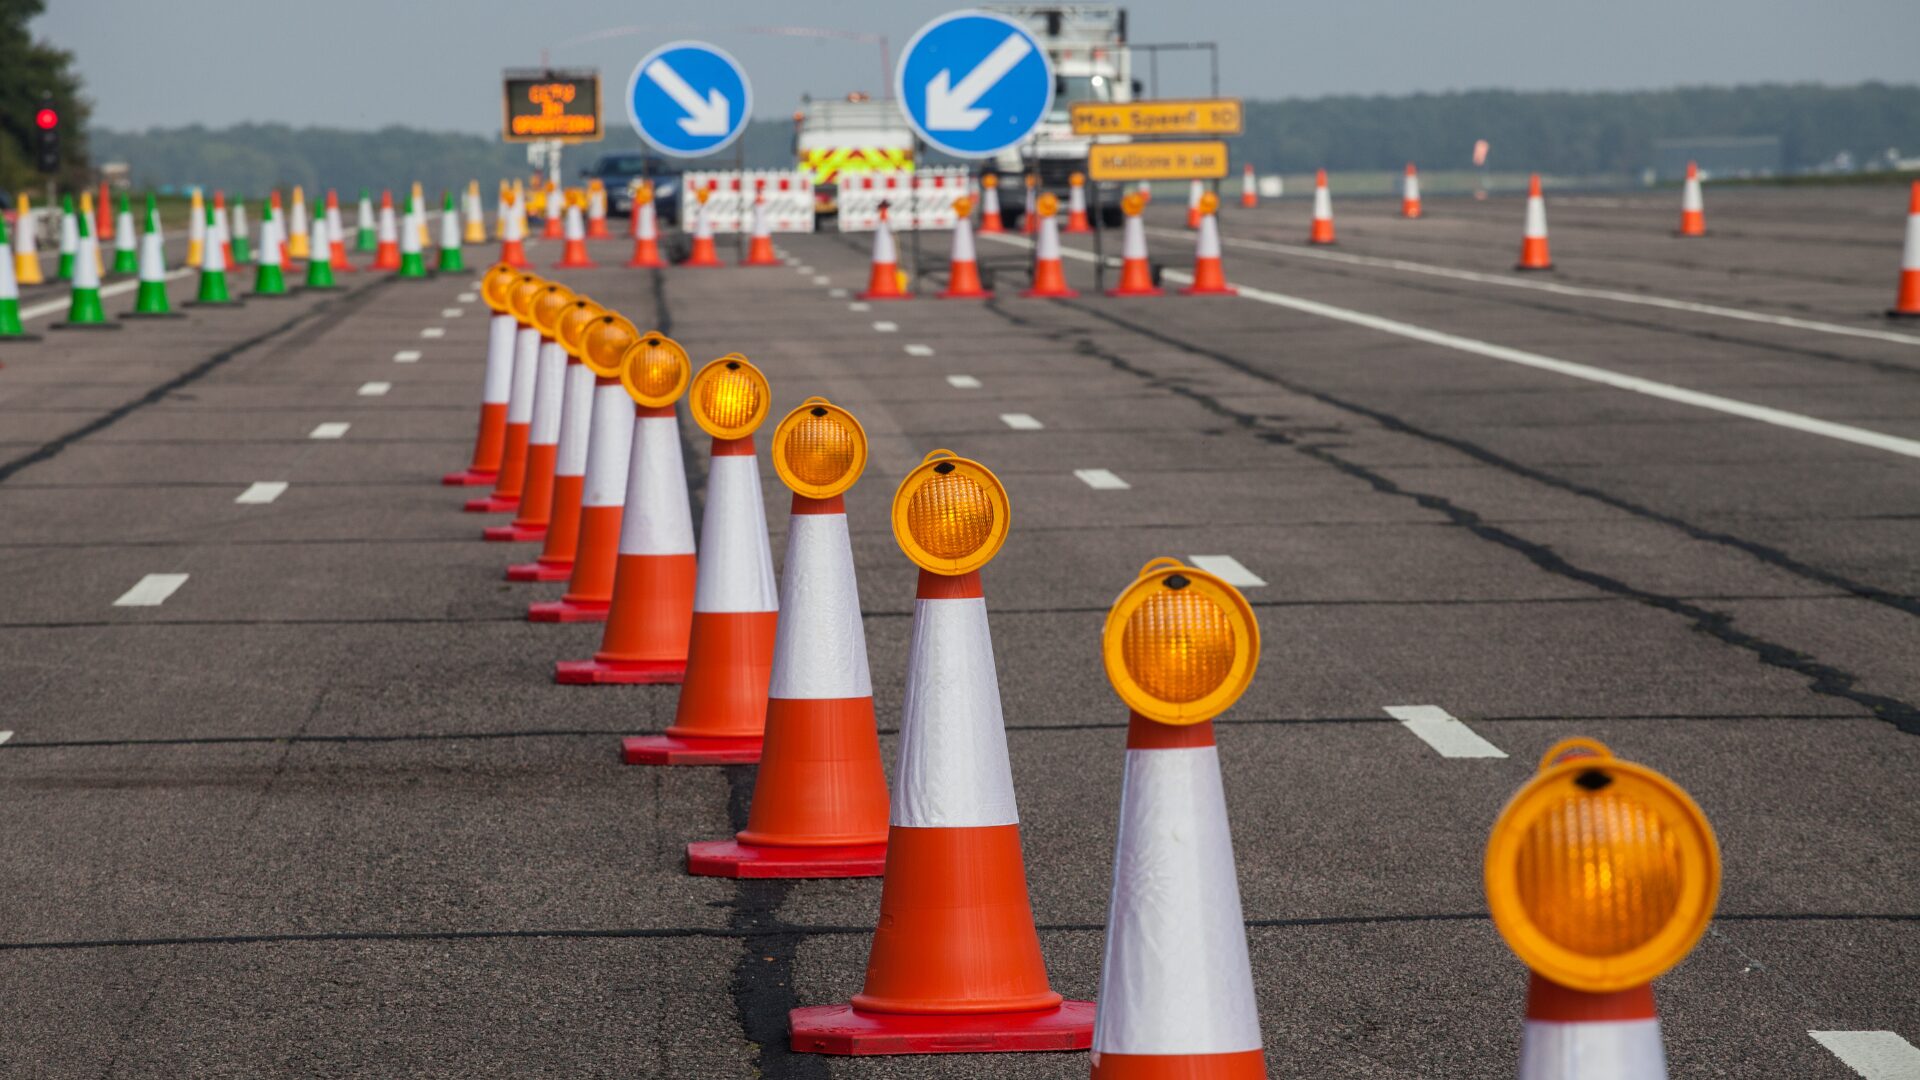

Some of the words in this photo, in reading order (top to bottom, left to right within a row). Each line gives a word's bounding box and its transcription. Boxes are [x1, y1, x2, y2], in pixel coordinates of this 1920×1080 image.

[1077, 113, 1121, 128] Max
[1130, 111, 1199, 128] Speed
[1211, 107, 1234, 123] 10
